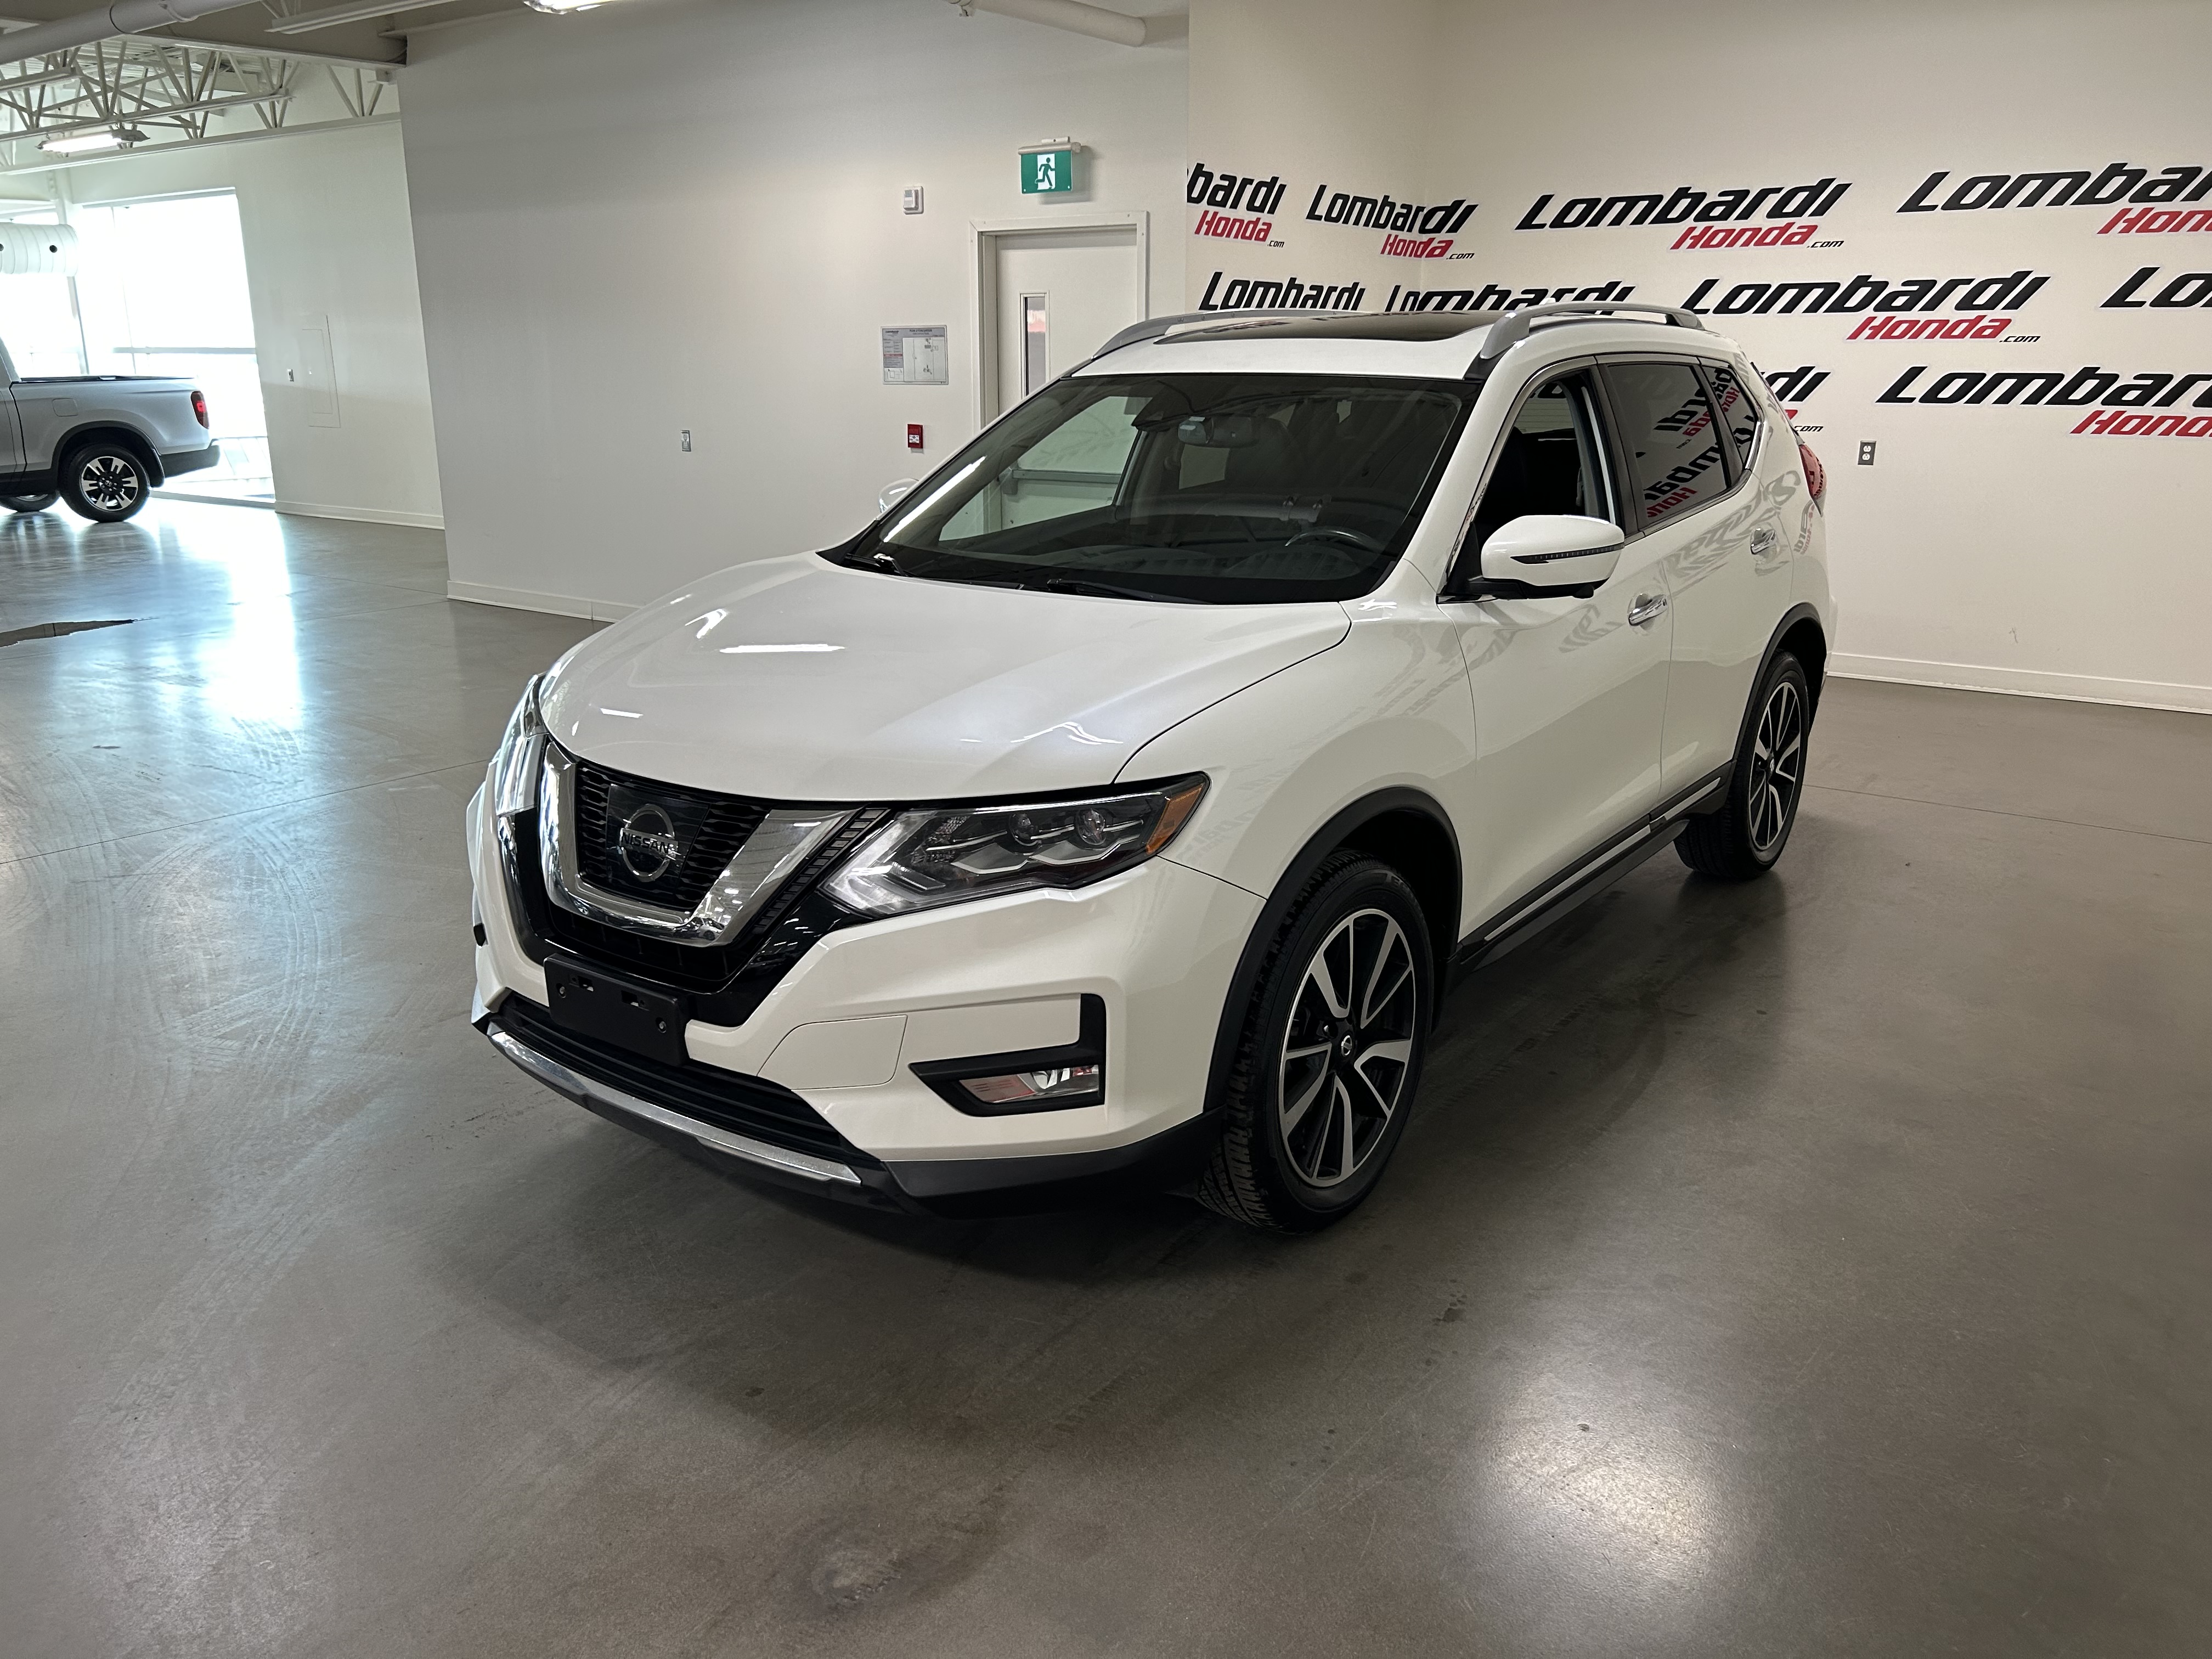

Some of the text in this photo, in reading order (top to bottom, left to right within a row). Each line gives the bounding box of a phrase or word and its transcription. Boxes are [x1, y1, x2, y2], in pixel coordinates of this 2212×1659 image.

[1187, 162, 1287, 215] bardi
[1515, 177, 1853, 230] Lombardi
[1194, 210, 1272, 242] Honda
[1306, 184, 1479, 234] Lombardi
[2097, 206, 2212, 234] Hon
[1380, 234, 1454, 258] Honda
[1670, 222, 1844, 250] Honda .com
[1680, 270, 2051, 314] Lombardi
[2100, 267, 2212, 308] Lo
[1847, 314, 2012, 340] Honda
[1875, 366, 2212, 408] Lombar
[621, 831, 672, 854] NISSAN
